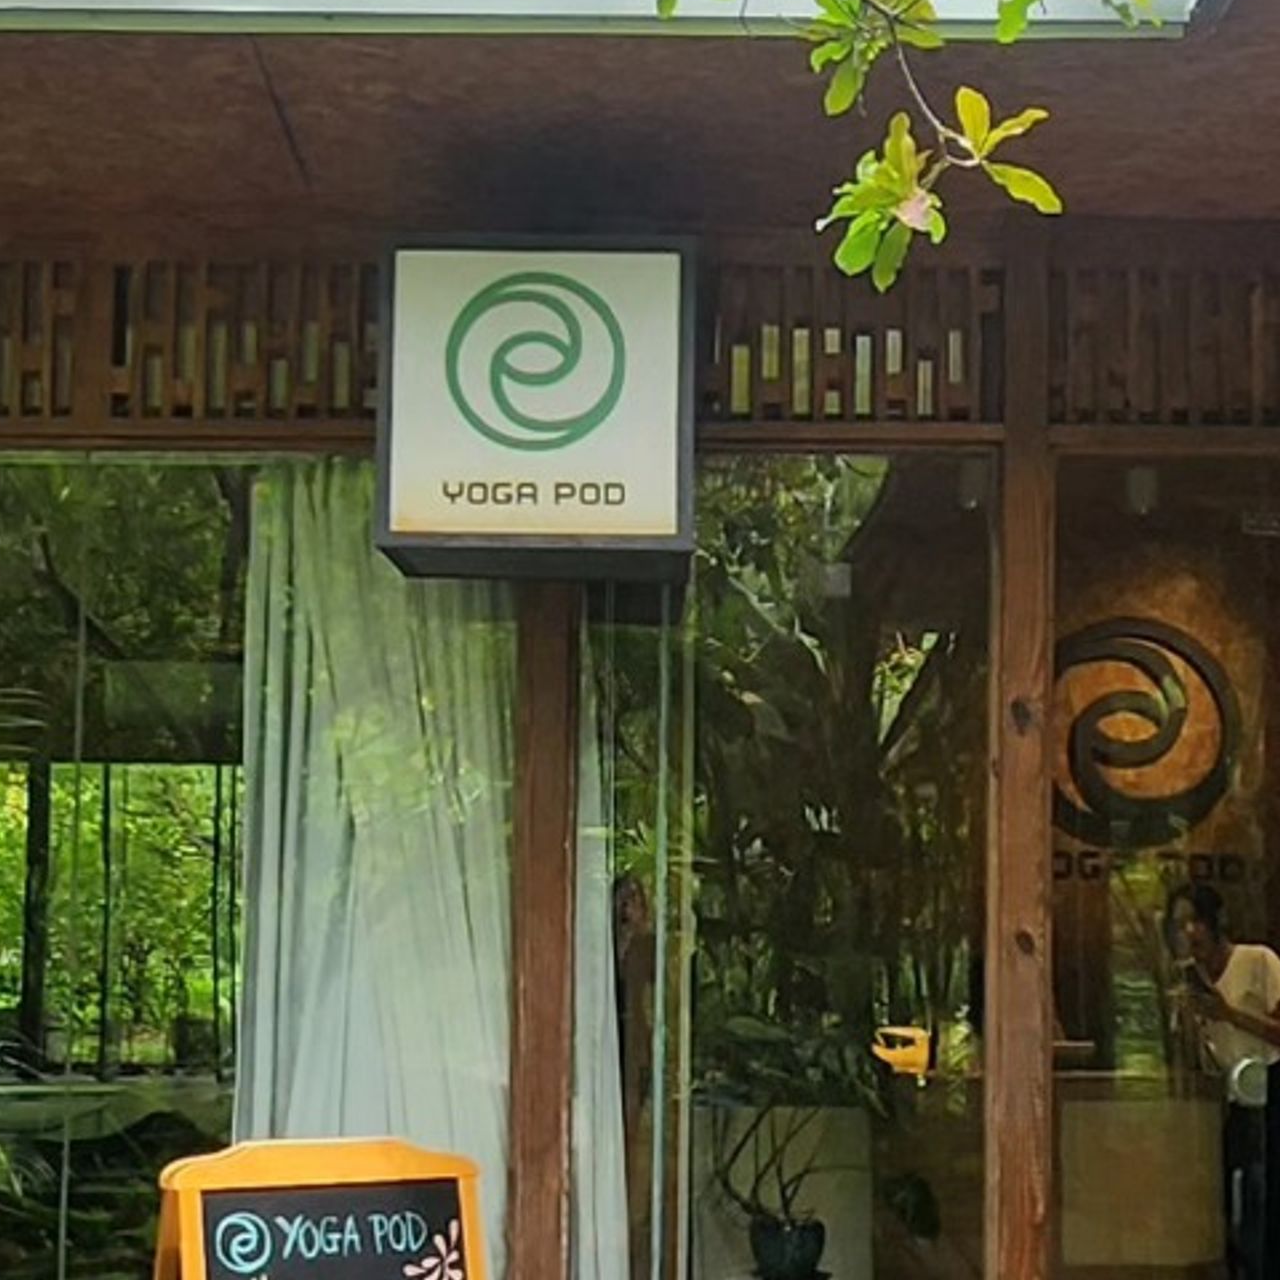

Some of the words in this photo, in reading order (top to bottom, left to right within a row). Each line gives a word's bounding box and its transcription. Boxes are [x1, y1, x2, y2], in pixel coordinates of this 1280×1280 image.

[442, 481, 538, 505] YOGA
[554, 482, 626, 505] POD
[276, 1214, 362, 1260] YOGA
[370, 1212, 428, 1255] POD
